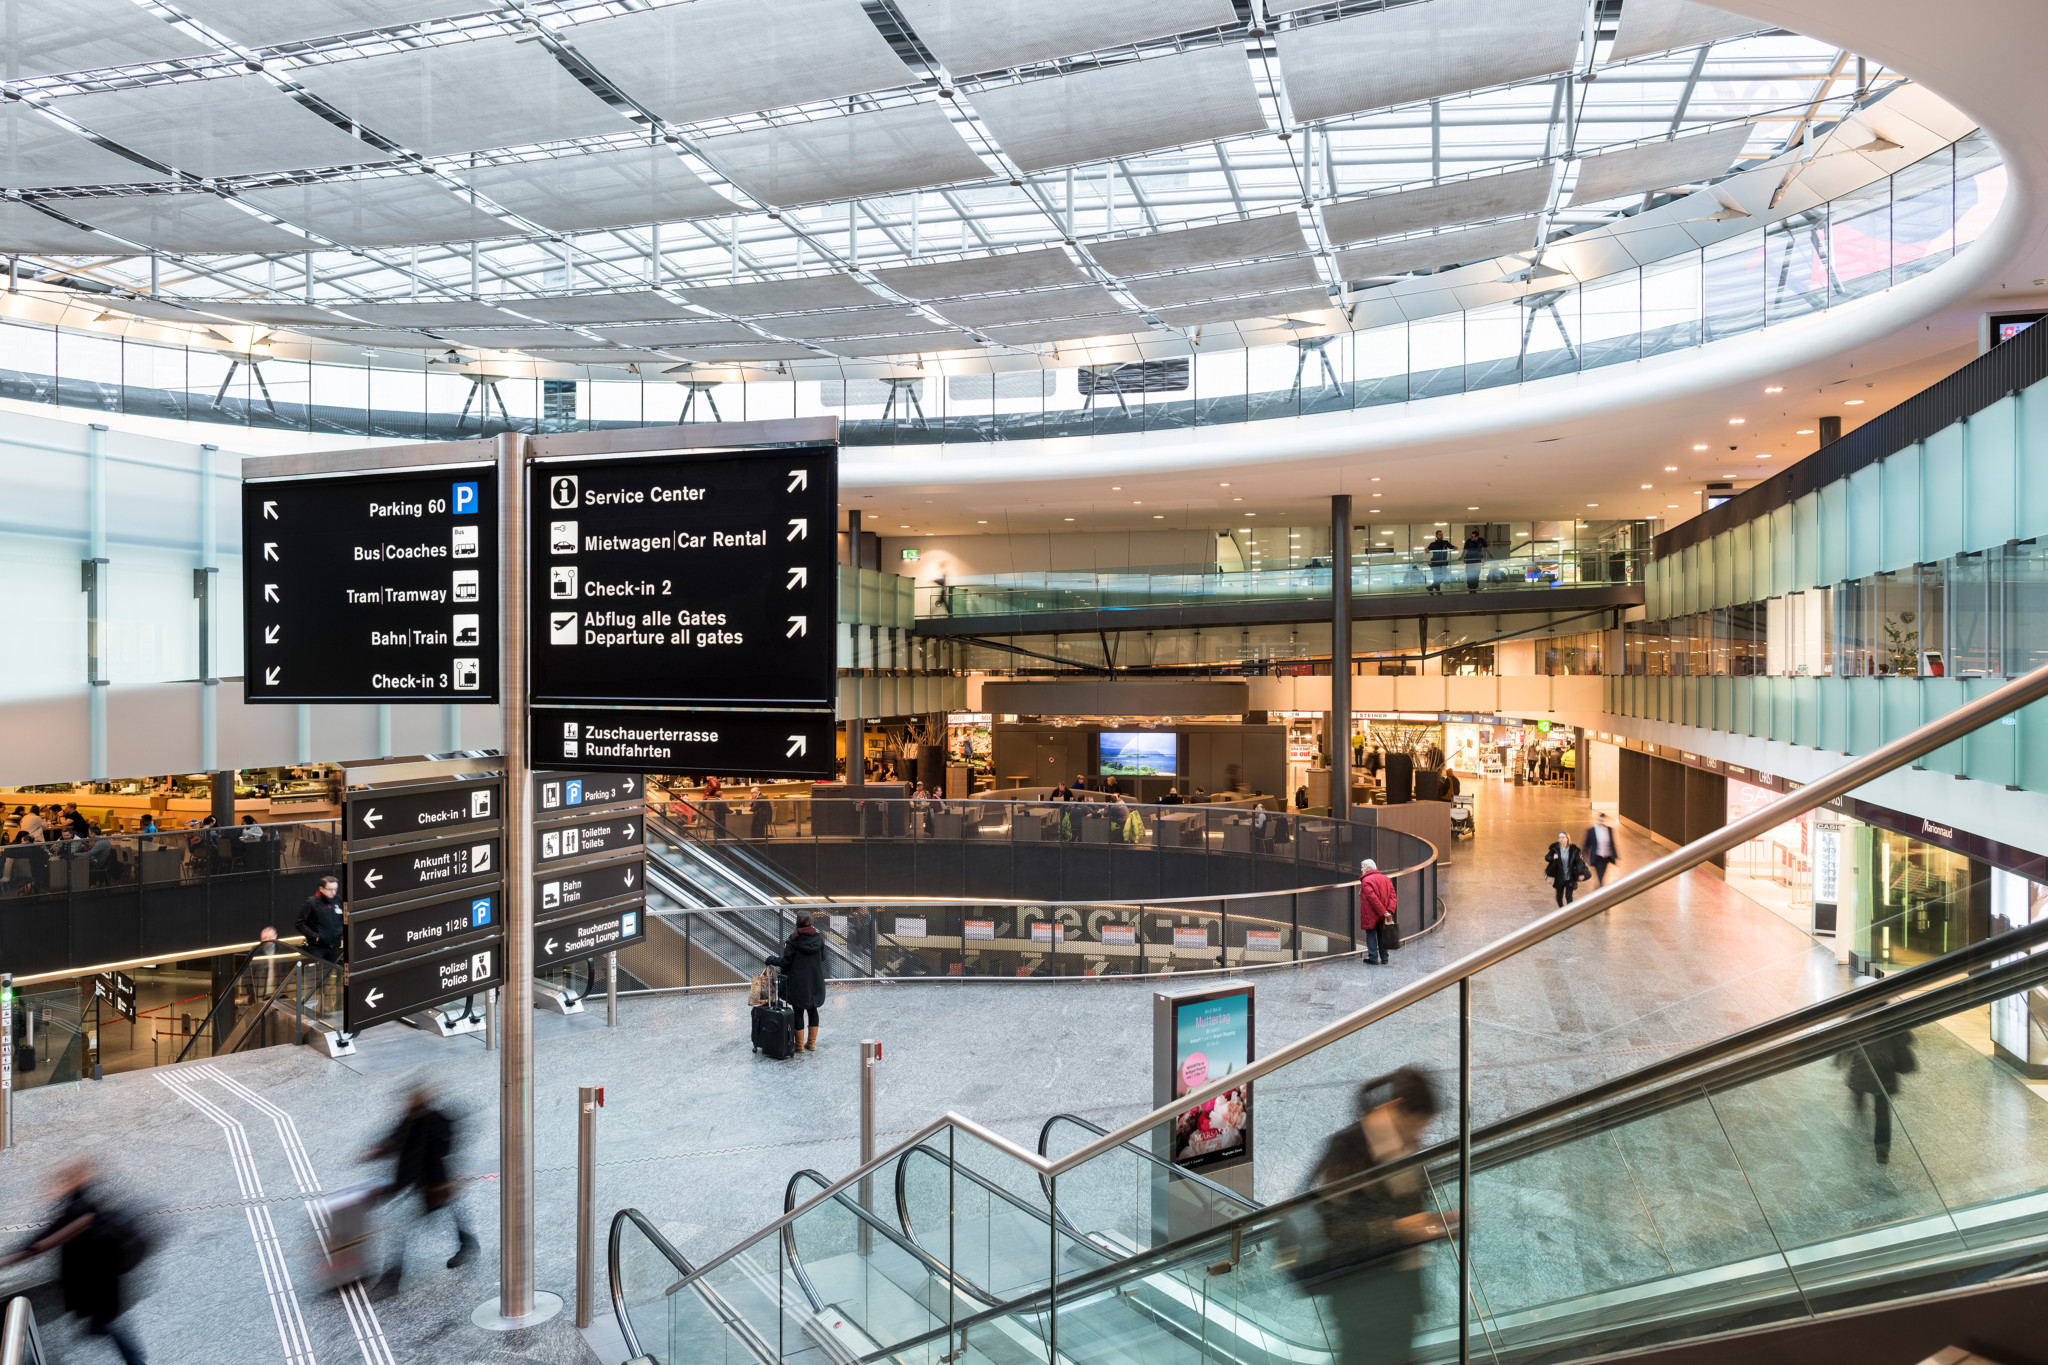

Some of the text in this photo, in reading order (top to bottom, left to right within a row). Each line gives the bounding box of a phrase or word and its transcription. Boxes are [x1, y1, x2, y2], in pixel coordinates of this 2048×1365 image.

[585, 485, 706, 505] Service Center
[369, 498, 446, 518] Parking 60
[713, 530, 767, 547] Rental
[584, 579, 672, 597] Check-in 2
[584, 609, 727, 628] Abflug alle Gates
[585, 629, 744, 648] Departure all gates
[372, 673, 448, 689] Check-in 3
[585, 726, 719, 743] Zuschauerterrasse
[585, 742, 671, 758] Rundfahrten
[1758, 770, 1773, 786] CHRIST
[584, 790, 610, 801] Parking
[611, 788, 616, 798] 3
[1741, 786, 1775, 802] SAL
[417, 807, 466, 824] Check-in 1
[581, 826, 611, 839] Toiletten
[1921, 818, 1953, 839] Marionnaud
[581, 838, 605, 850] Toilets
[413, 853, 451, 870] Ankunft
[419, 866, 450, 882] Arrival
[562, 880, 582, 892] Bahn
[562, 891, 581, 903] Train
[406, 925, 443, 942] Parking
[577, 919, 620, 938] Raucherzone
[564, 930, 620, 953] Smoking Lounge
[439, 959, 468, 977] Polizei
[441, 973, 468, 989] Police
[1195, 1013, 1231, 1029] Muttertag
